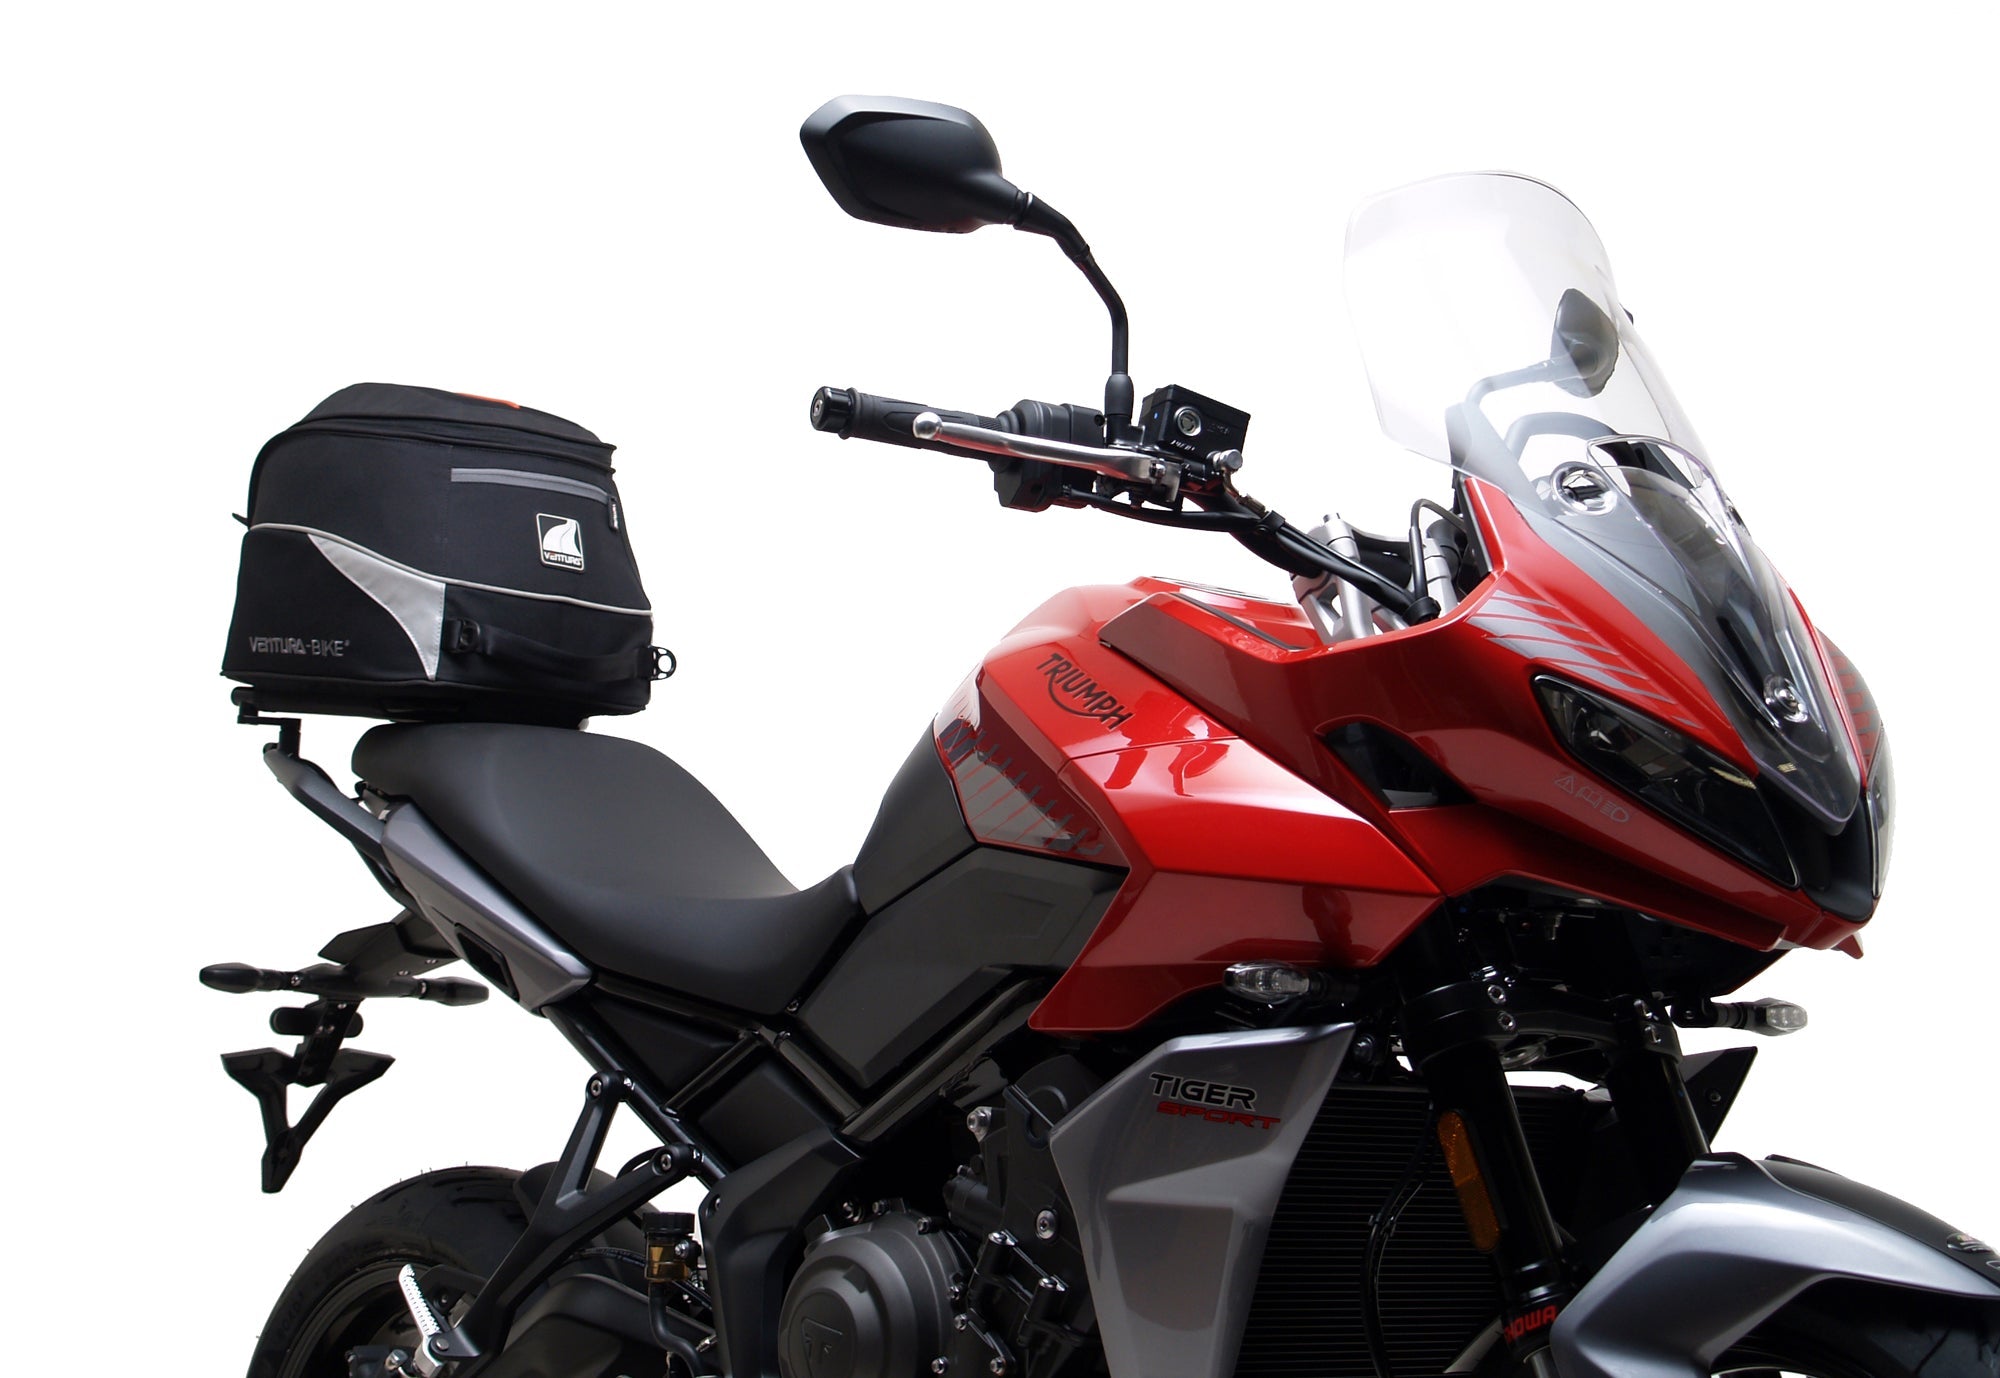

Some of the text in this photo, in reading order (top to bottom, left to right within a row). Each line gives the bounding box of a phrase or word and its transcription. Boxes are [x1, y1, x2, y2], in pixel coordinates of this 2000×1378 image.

[1036, 653, 1134, 730] TRIUMPH
[1149, 1072, 1256, 1111] TIGER
[1156, 1101, 1281, 1130] SPORT
